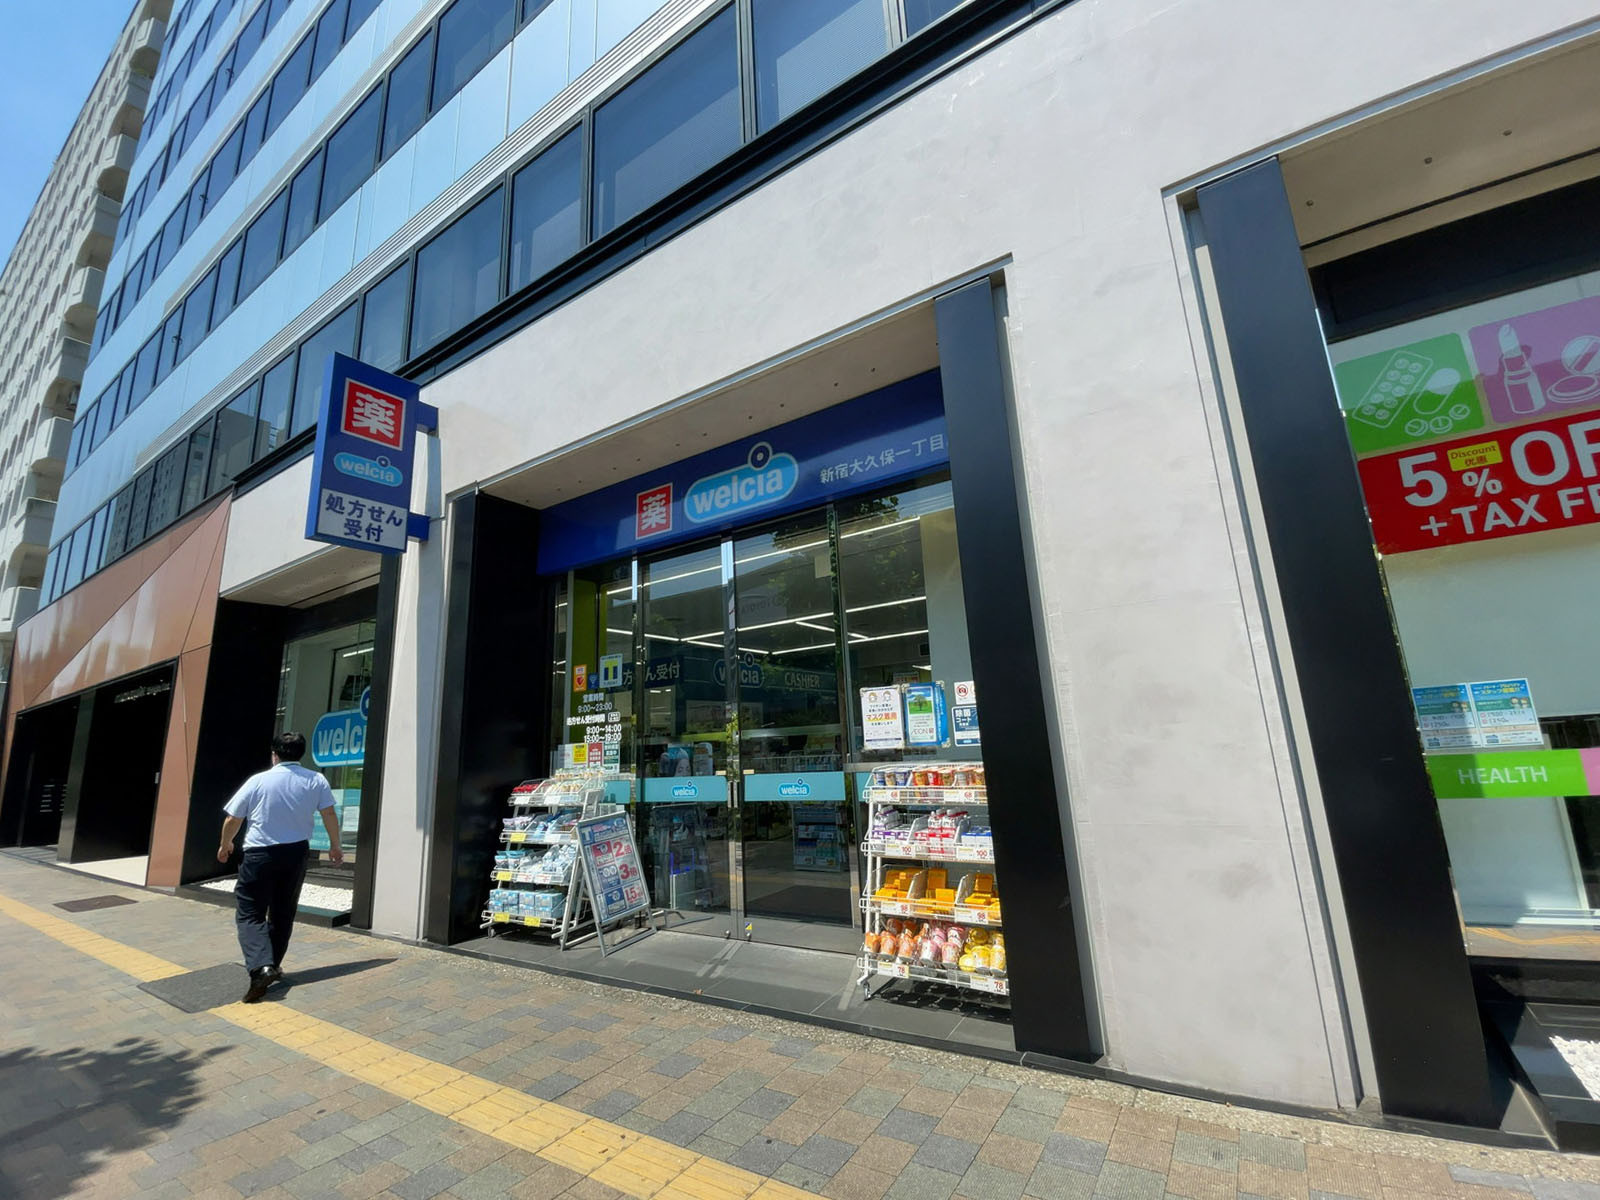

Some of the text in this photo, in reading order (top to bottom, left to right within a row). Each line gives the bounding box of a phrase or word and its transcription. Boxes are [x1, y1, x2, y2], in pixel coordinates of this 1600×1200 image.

[352, 391, 396, 439] 薬
[820, 434, 945, 484] 新宿大久保一丁目
[1450, 445, 1496, 459] Discount
[340, 457, 396, 483] welcia
[1398, 451, 1448, 507] 5
[1462, 468, 1503, 497] %
[692, 467, 784, 514] welcia
[325, 493, 404, 528] 処方せん
[641, 493, 667, 531] 薬
[343, 517, 384, 543] 受付
[785, 672, 820, 688] CASHIER
[1457, 765, 1549, 785] HEALTH
[673, 786, 695, 797] welcia
[780, 784, 807, 796] welcia
